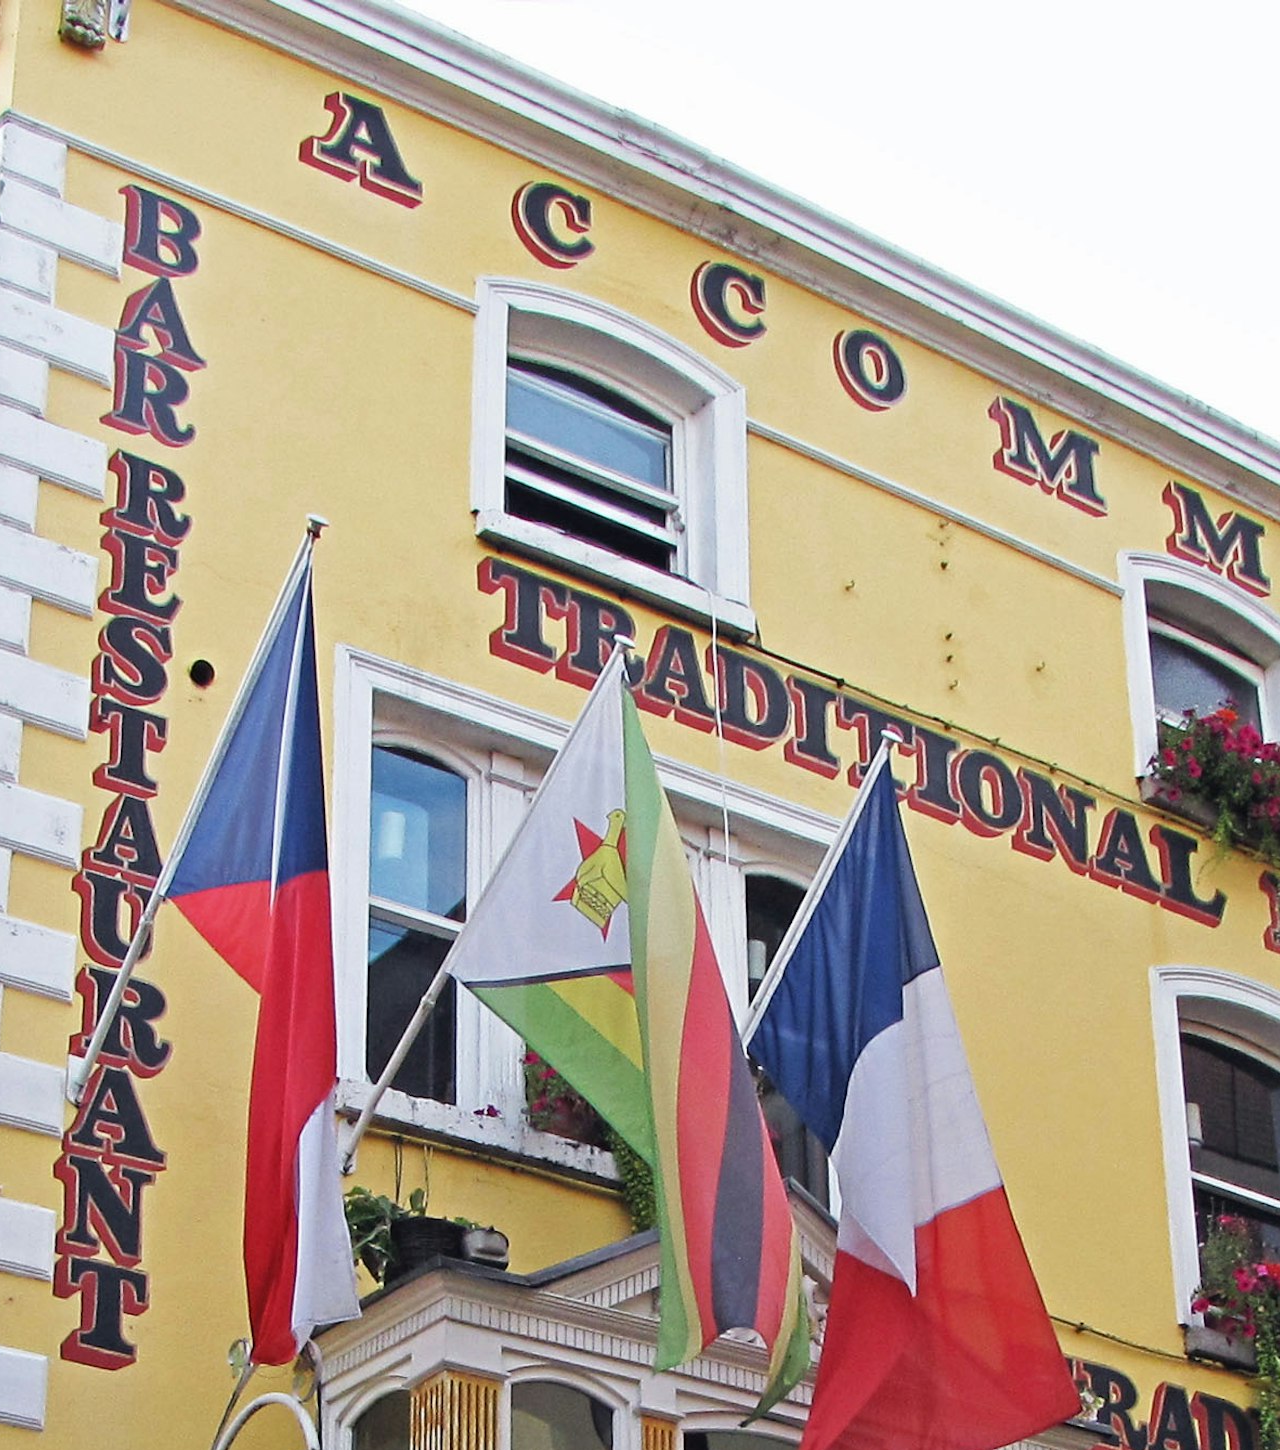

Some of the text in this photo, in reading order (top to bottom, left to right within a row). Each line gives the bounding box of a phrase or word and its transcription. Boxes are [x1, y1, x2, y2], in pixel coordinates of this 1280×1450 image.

[52, 183, 207, 1372] BAR RESTAURANT
[476, 556, 1227, 927] TRADITIONAL
